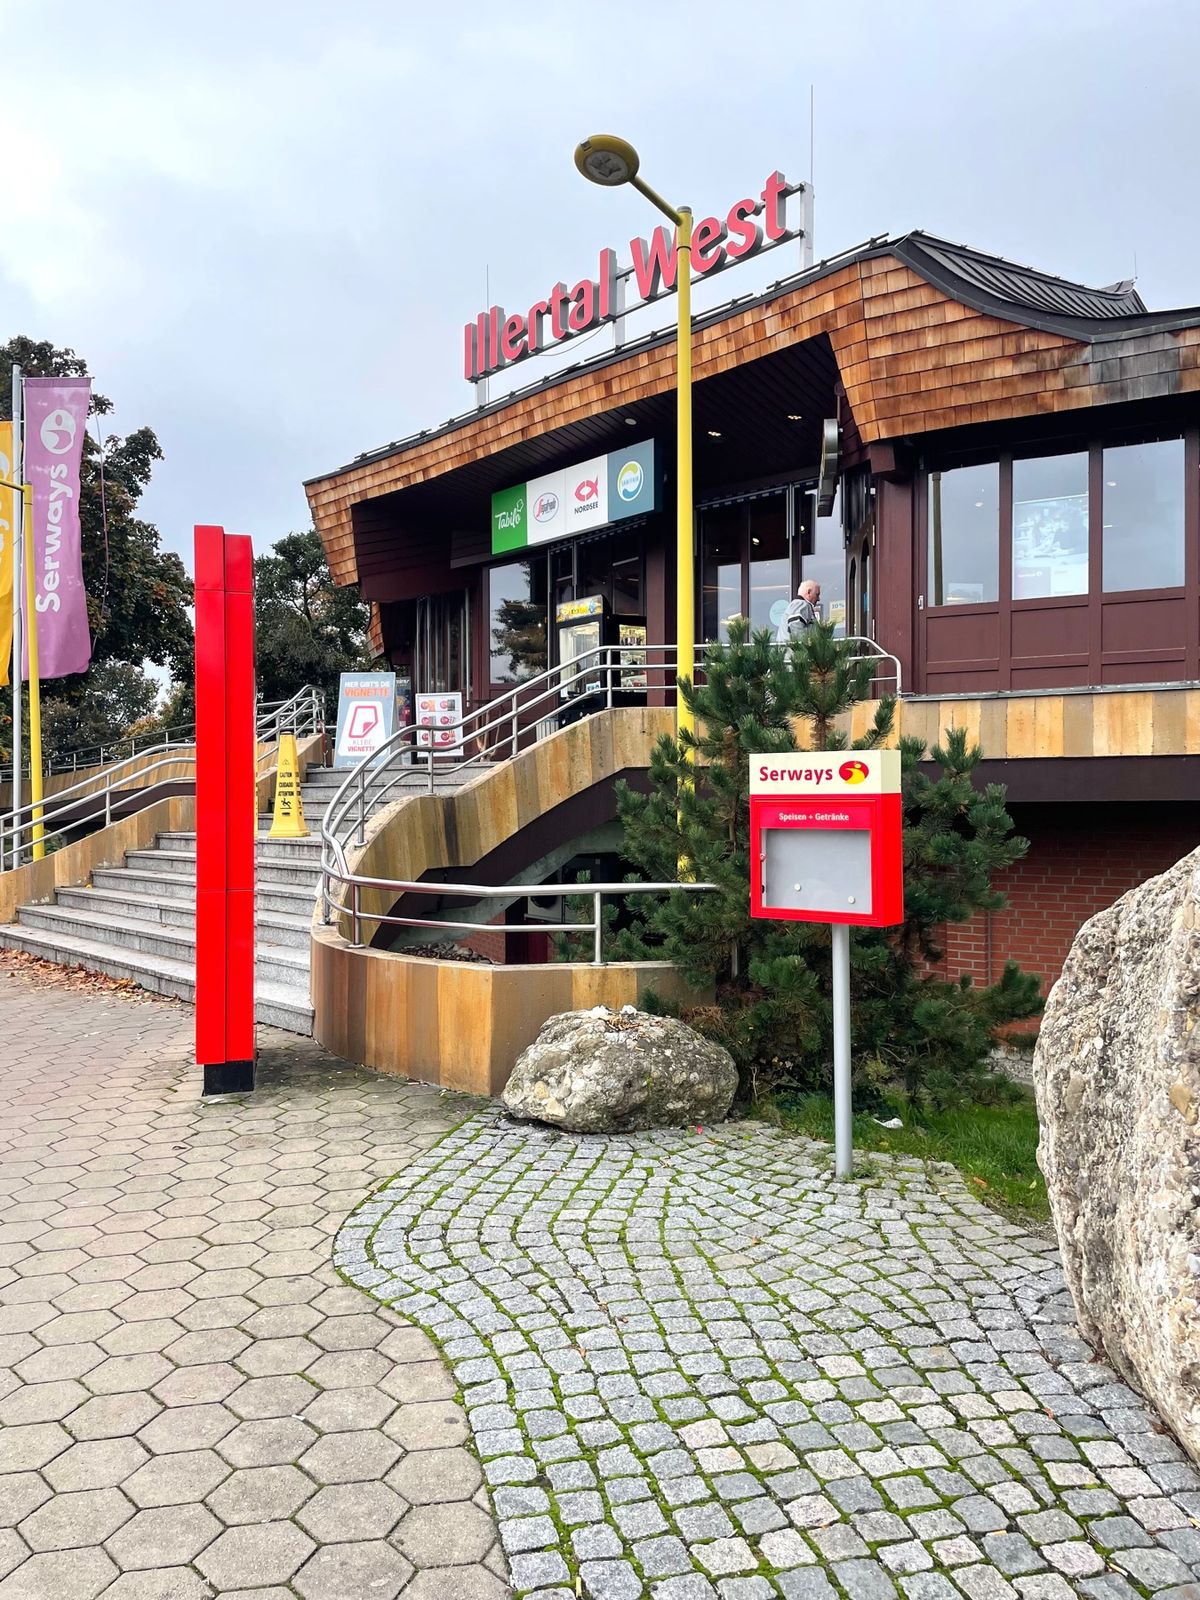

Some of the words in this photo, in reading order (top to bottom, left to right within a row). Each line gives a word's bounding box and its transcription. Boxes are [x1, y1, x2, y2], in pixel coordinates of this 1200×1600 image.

[464, 247, 616, 381] Illertal
[630, 170, 788, 301] West
[574, 501, 599, 515] NORDSEE
[35, 464, 73, 613] Serways
[344, 688, 389, 697] VIGNETTE
[759, 766, 833, 785] Serways
[778, 812, 807, 822] Speisen
[815, 812, 849, 821] Getränke
